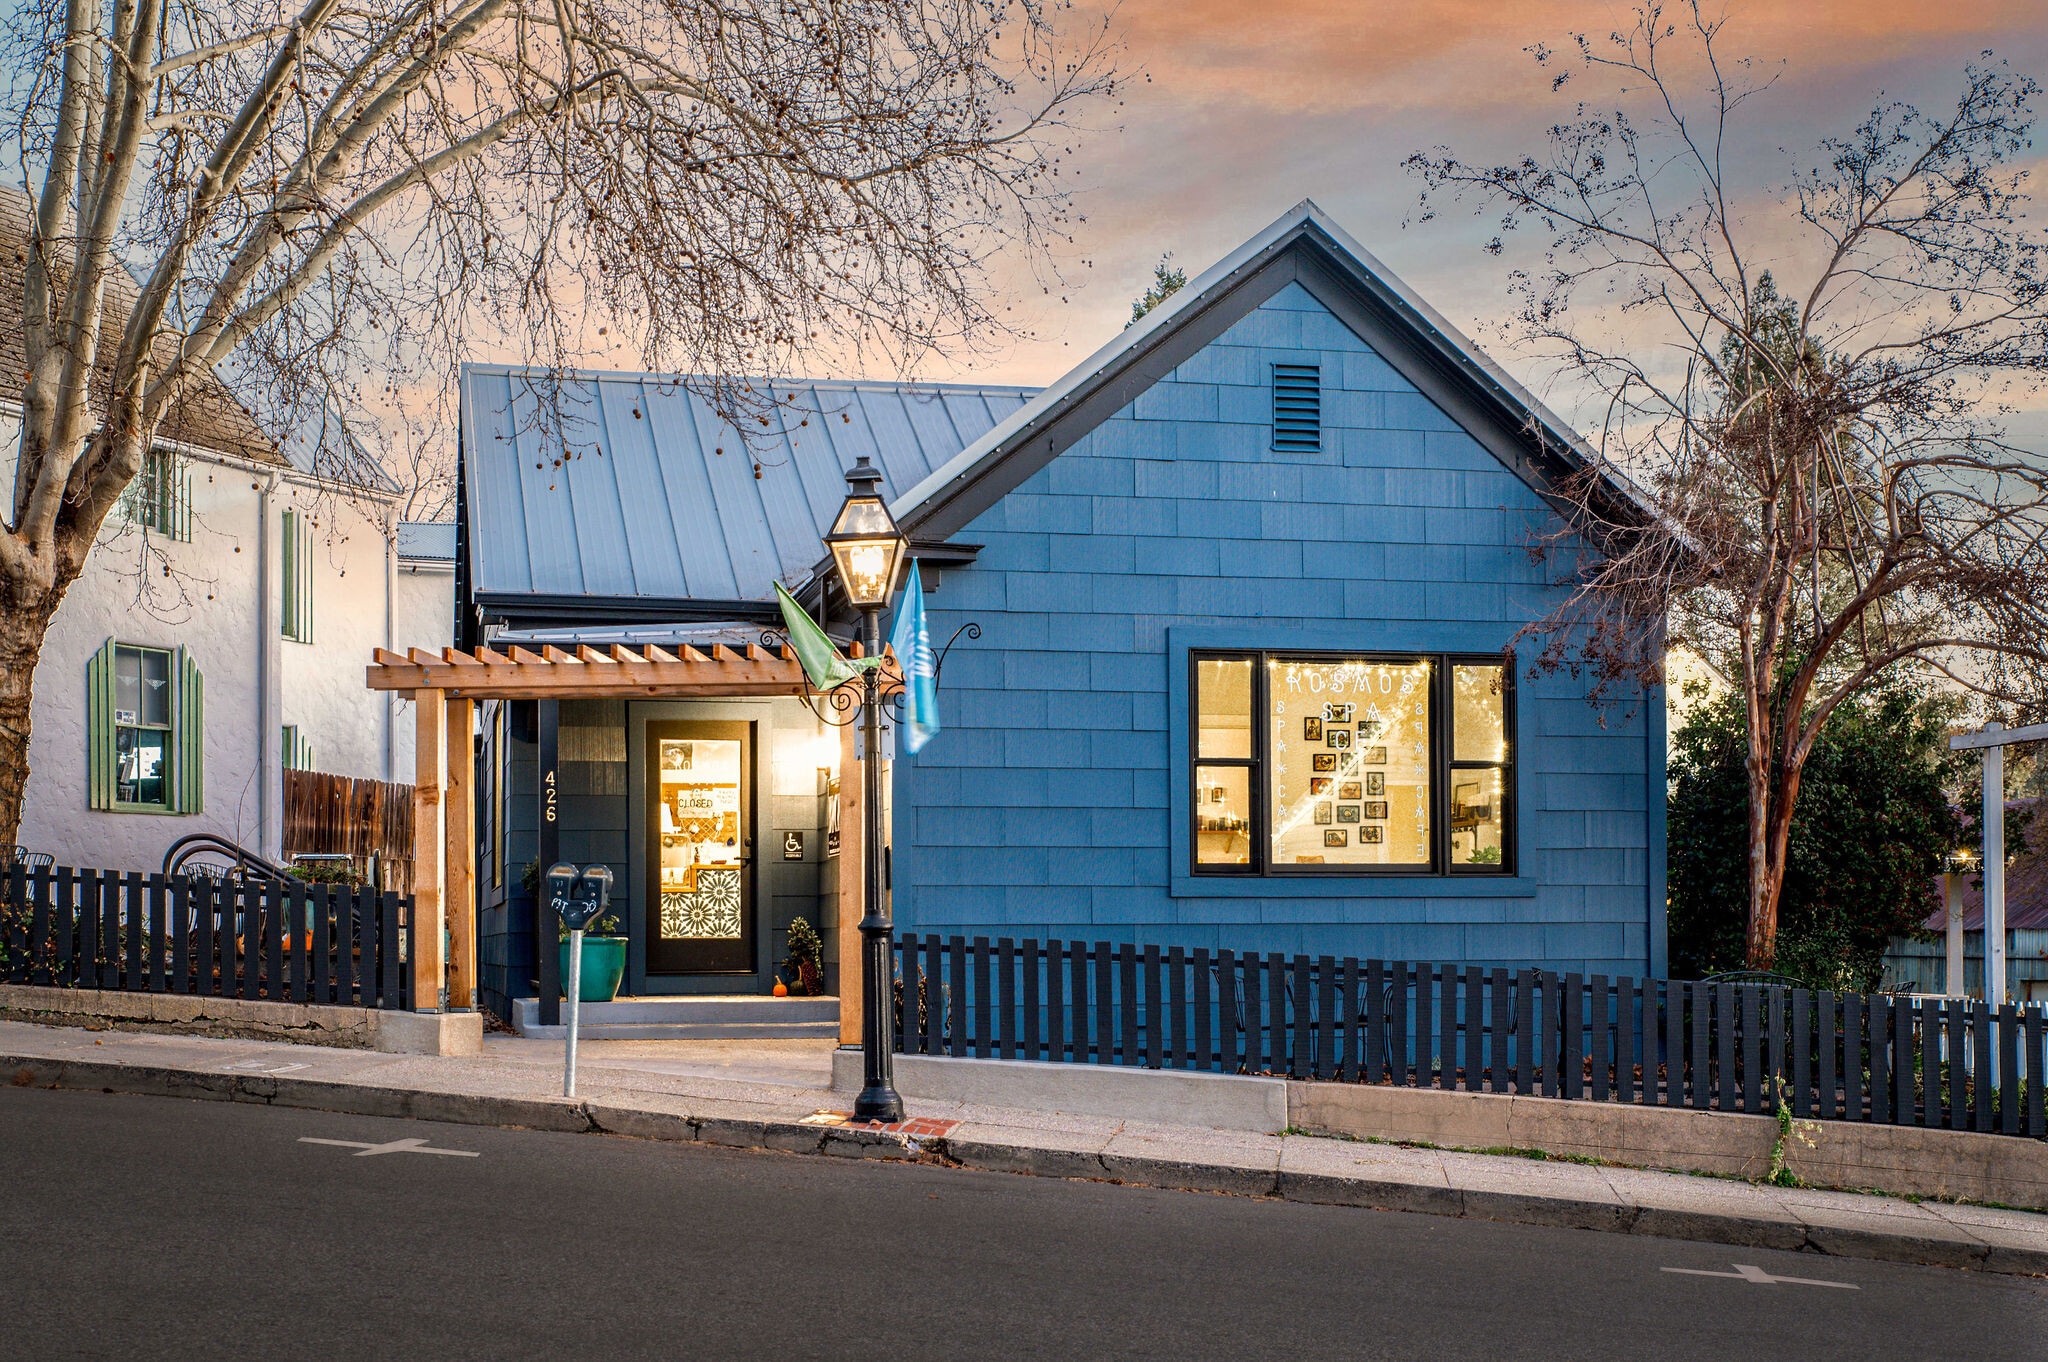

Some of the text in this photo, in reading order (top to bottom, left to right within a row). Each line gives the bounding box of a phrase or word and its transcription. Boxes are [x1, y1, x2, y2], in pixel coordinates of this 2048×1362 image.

[1286, 672, 1414, 694] KOSMOS
[1319, 701, 1381, 722] SPA
[545, 770, 557, 822] 426
[678, 799, 713, 808] CLOSED
